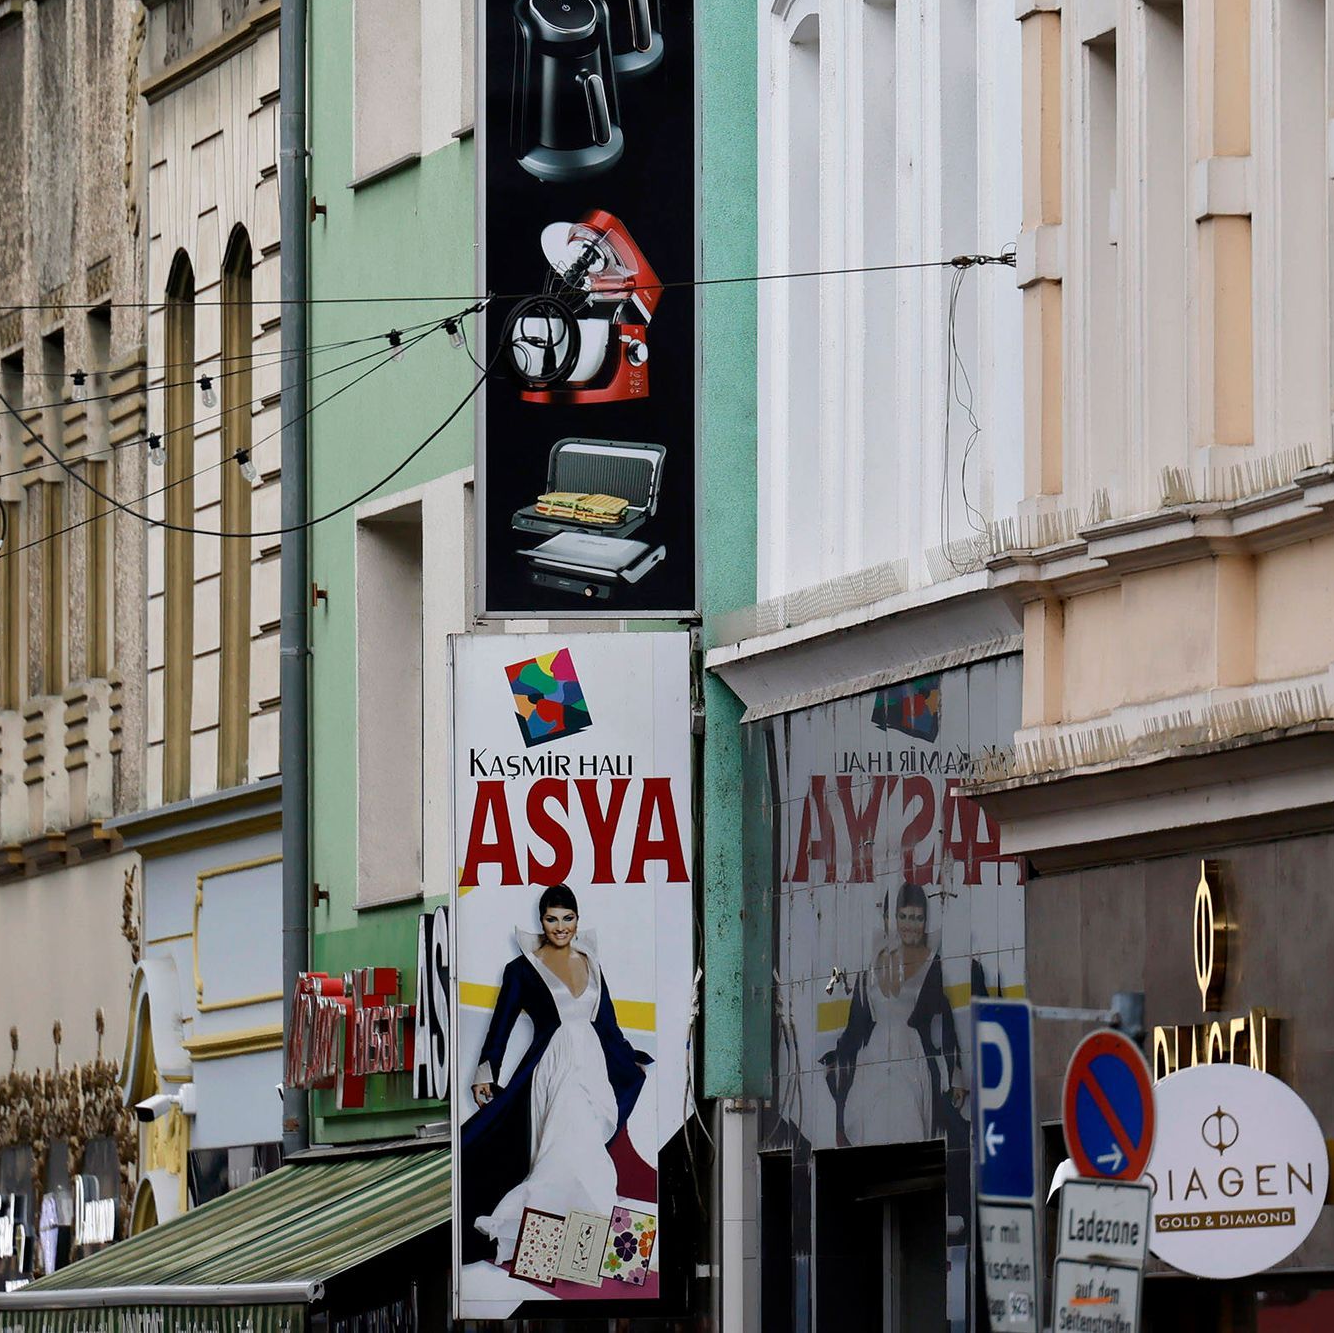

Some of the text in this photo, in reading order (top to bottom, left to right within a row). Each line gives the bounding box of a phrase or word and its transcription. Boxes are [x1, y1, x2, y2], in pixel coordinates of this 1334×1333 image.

[458, 777, 691, 886] ASYA
[978, 1021, 1013, 1165] P
[1068, 1208, 1139, 1245] Ladezone
[1159, 1211, 1292, 1230] GOLD & DIAMOND
[1075, 1280, 1094, 1299] auf
